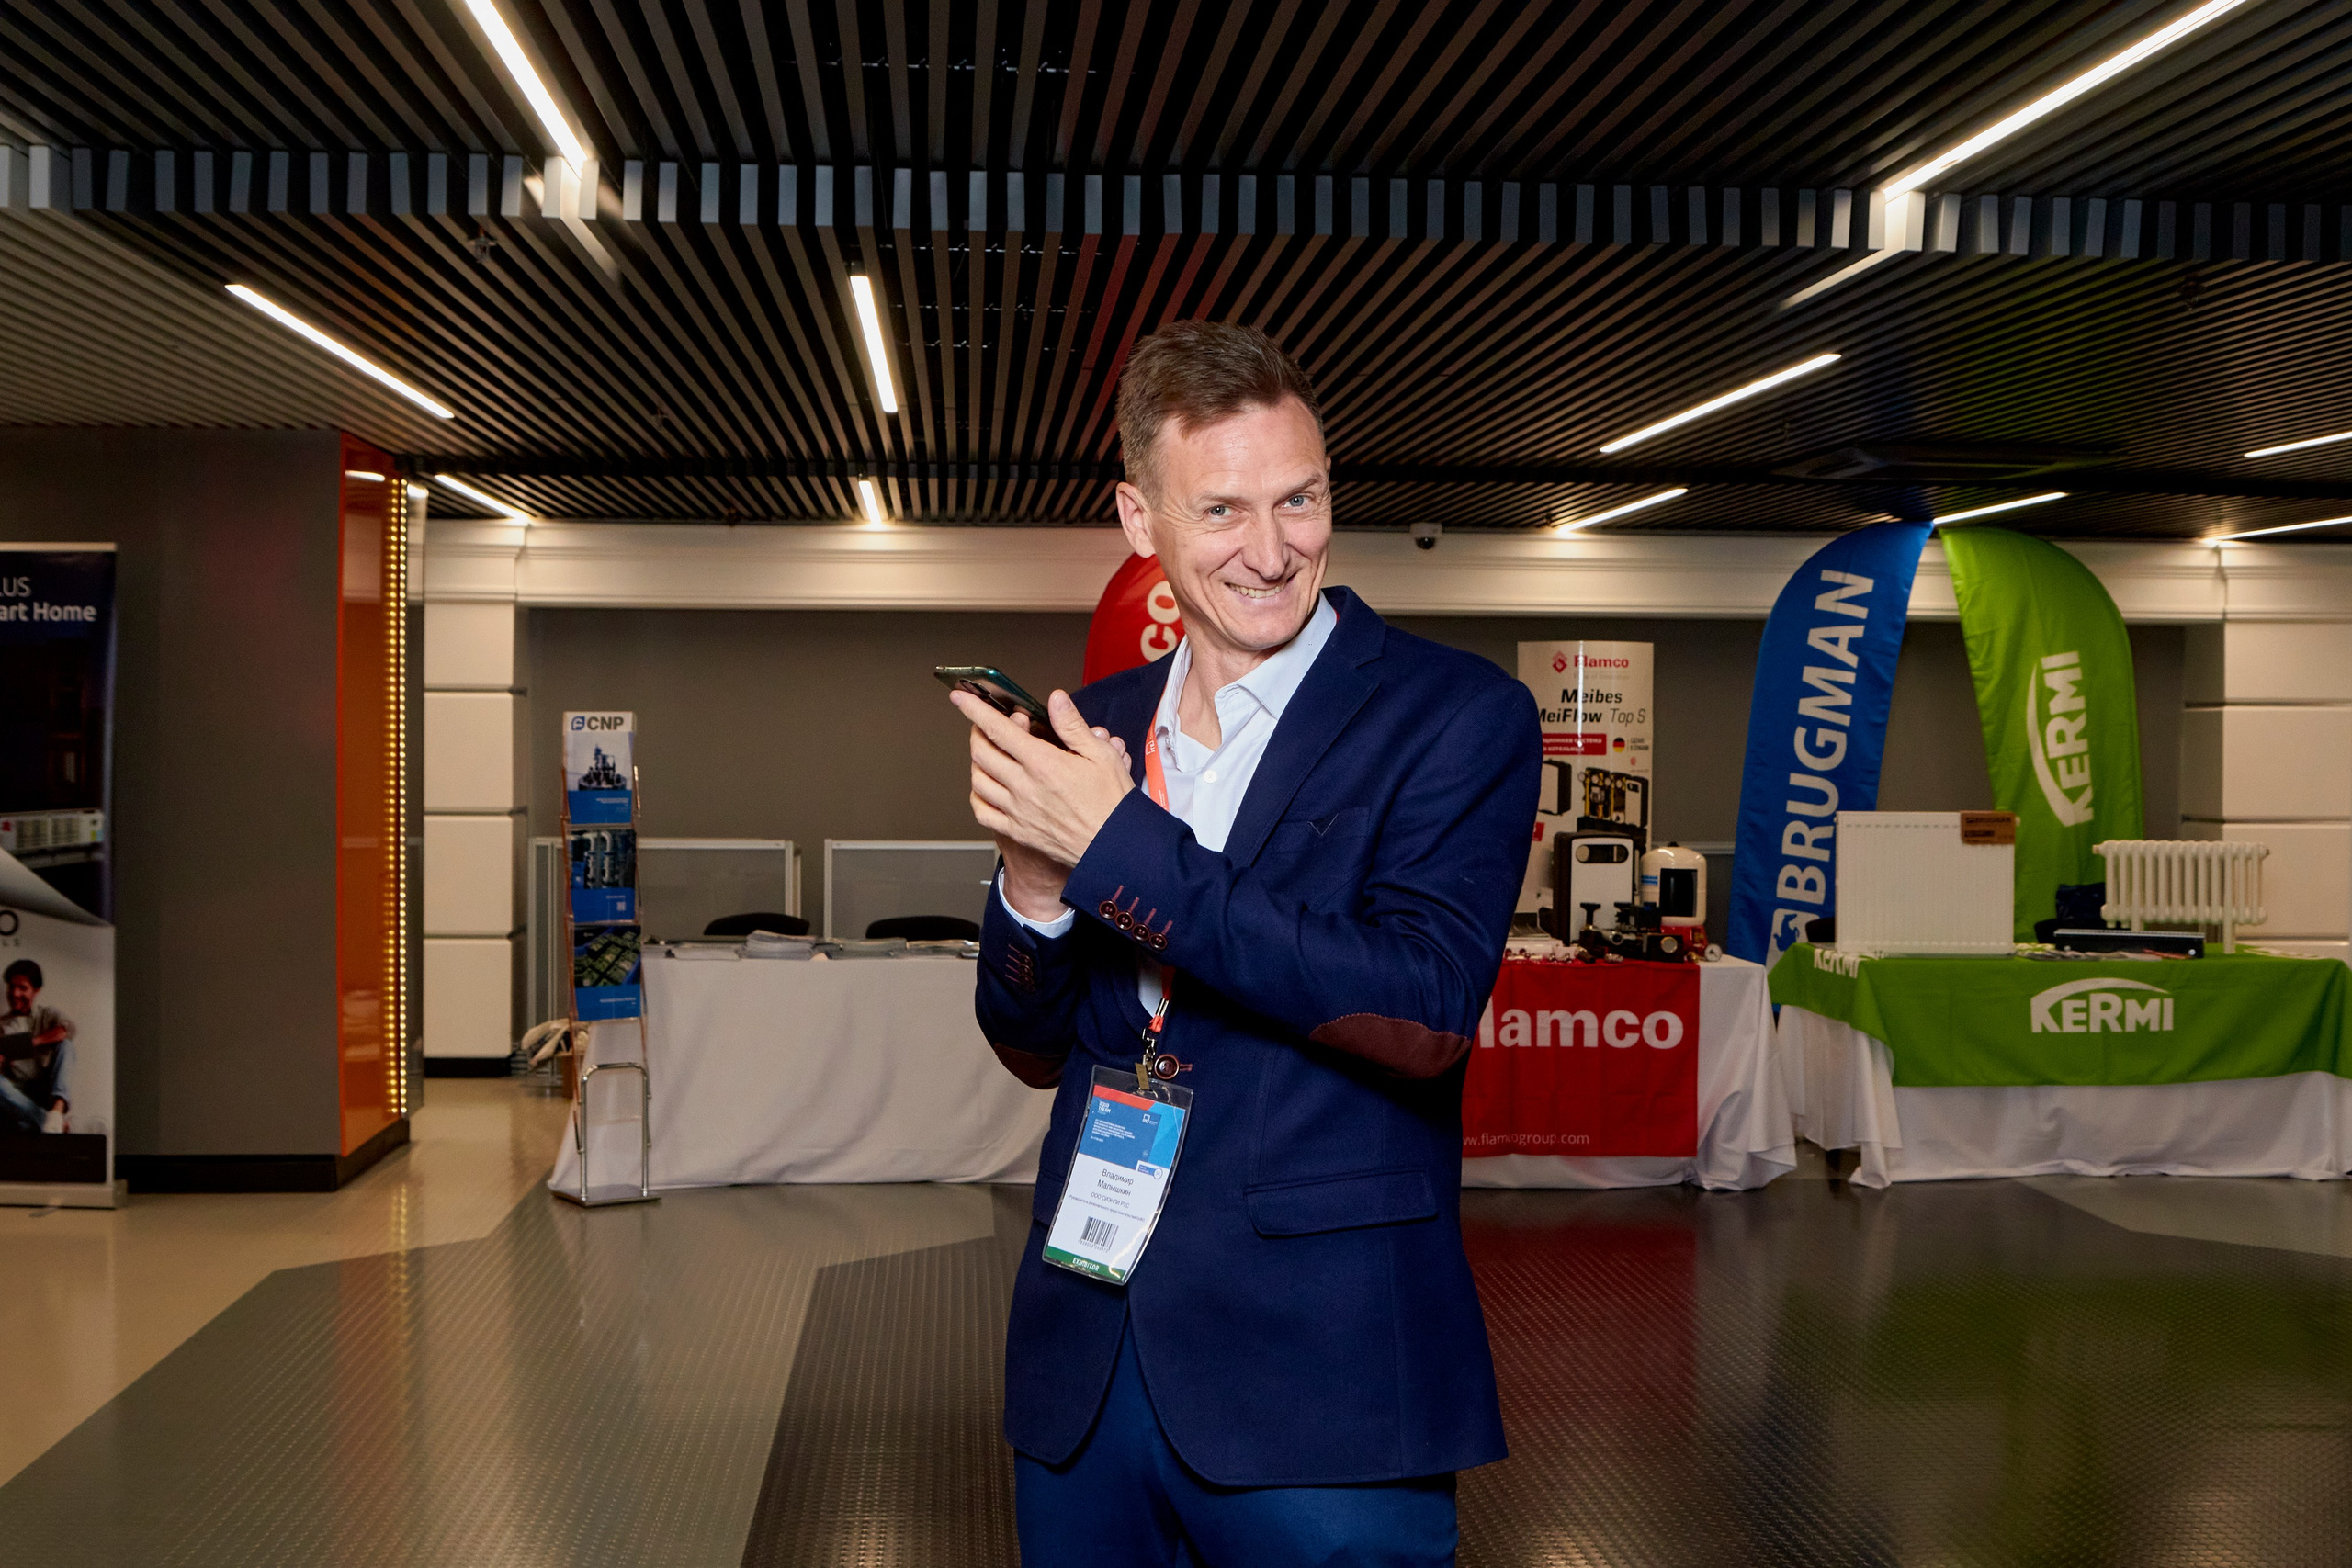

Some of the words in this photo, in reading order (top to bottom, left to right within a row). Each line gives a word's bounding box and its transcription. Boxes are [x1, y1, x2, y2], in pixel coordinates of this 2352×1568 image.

[0, 576, 31, 598] US
[0, 602, 28, 622] art
[33, 602, 97, 622] Home
[1561, 689, 1623, 704] Meibes
[587, 716, 624, 730] CNP
[1610, 708, 1634, 727] Top
[1636, 708, 1646, 724] S
[1776, 570, 1874, 906] BRUGMAN
[2030, 650, 2094, 827] KERMI
[2030, 981, 2174, 1033] KERMI
[1479, 995, 1683, 1049] lamco
[1463, 1132, 1590, 1146] ww.flamcogroup.com
[1102, 1168, 1134, 1186] Владимир
[1097, 1179, 1131, 1197] Малышкин
[1072, 1257, 1100, 1272] EXHIBITOR
